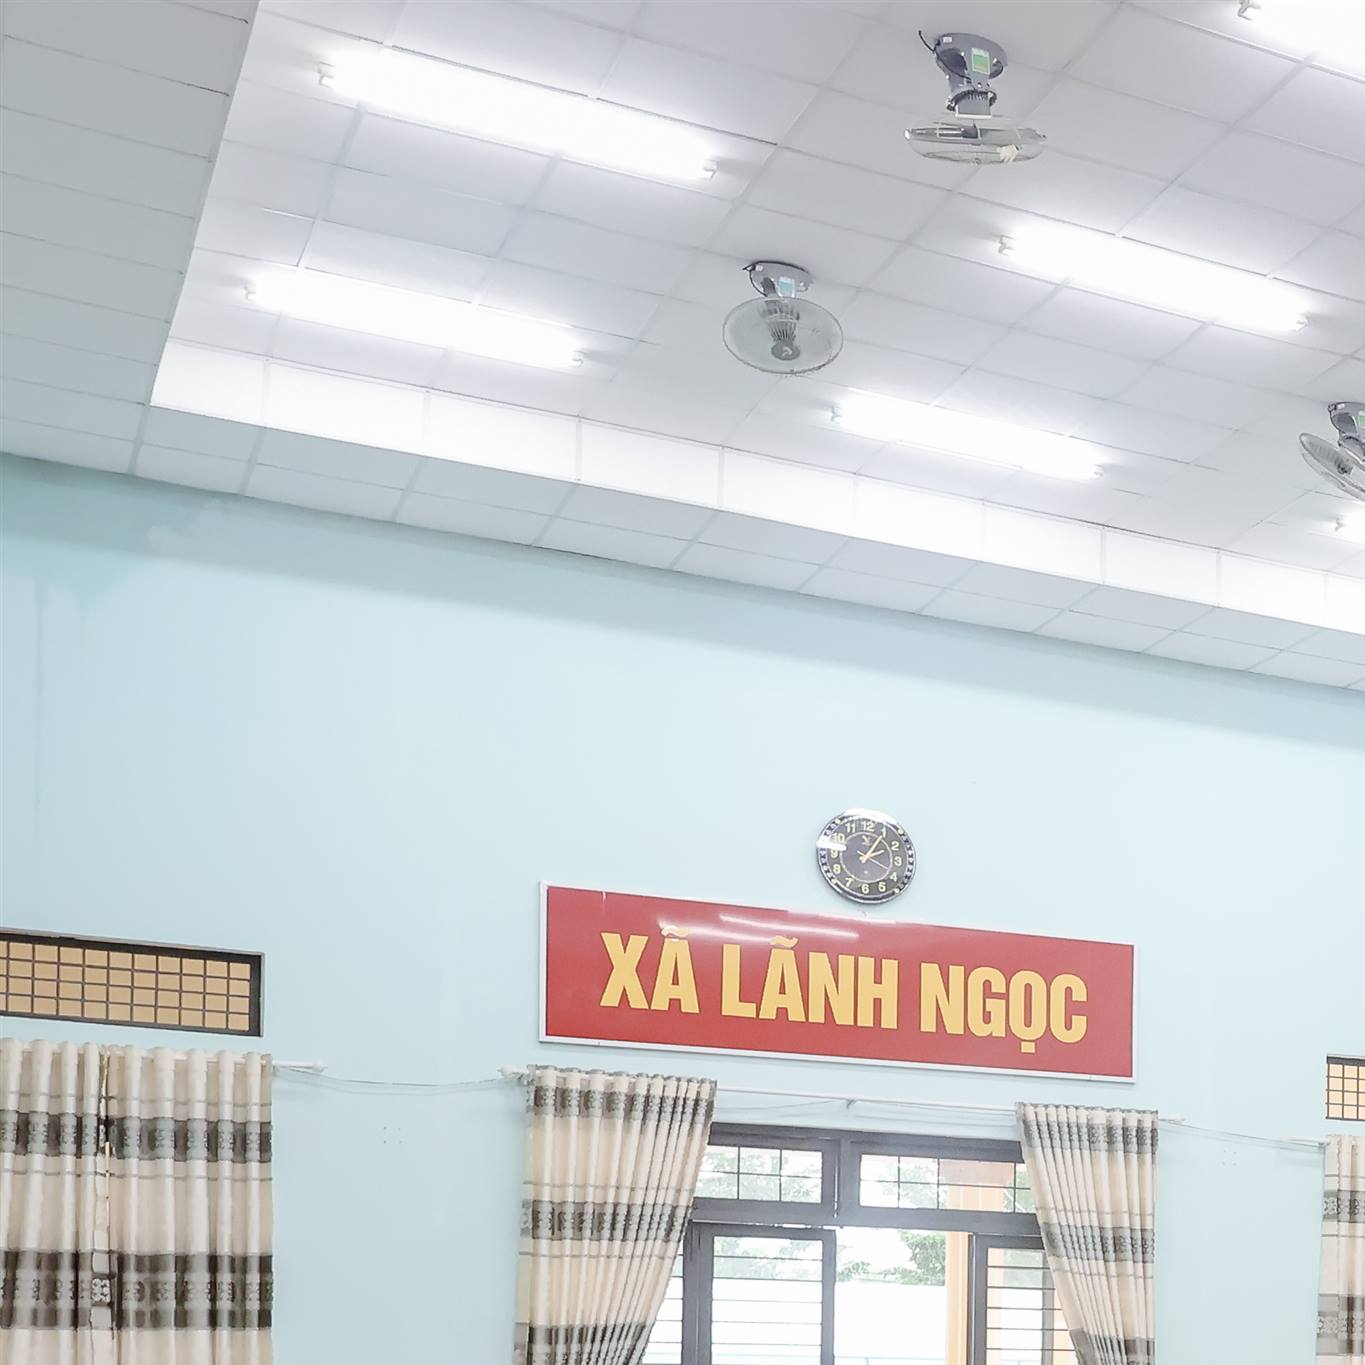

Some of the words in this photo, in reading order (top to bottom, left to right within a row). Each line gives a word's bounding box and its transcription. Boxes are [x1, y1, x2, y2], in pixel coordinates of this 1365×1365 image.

[600, 925, 700, 1014] XÃ
[721, 936, 899, 1029] LÃNH
[920, 962, 1088, 1054] NGỌC
